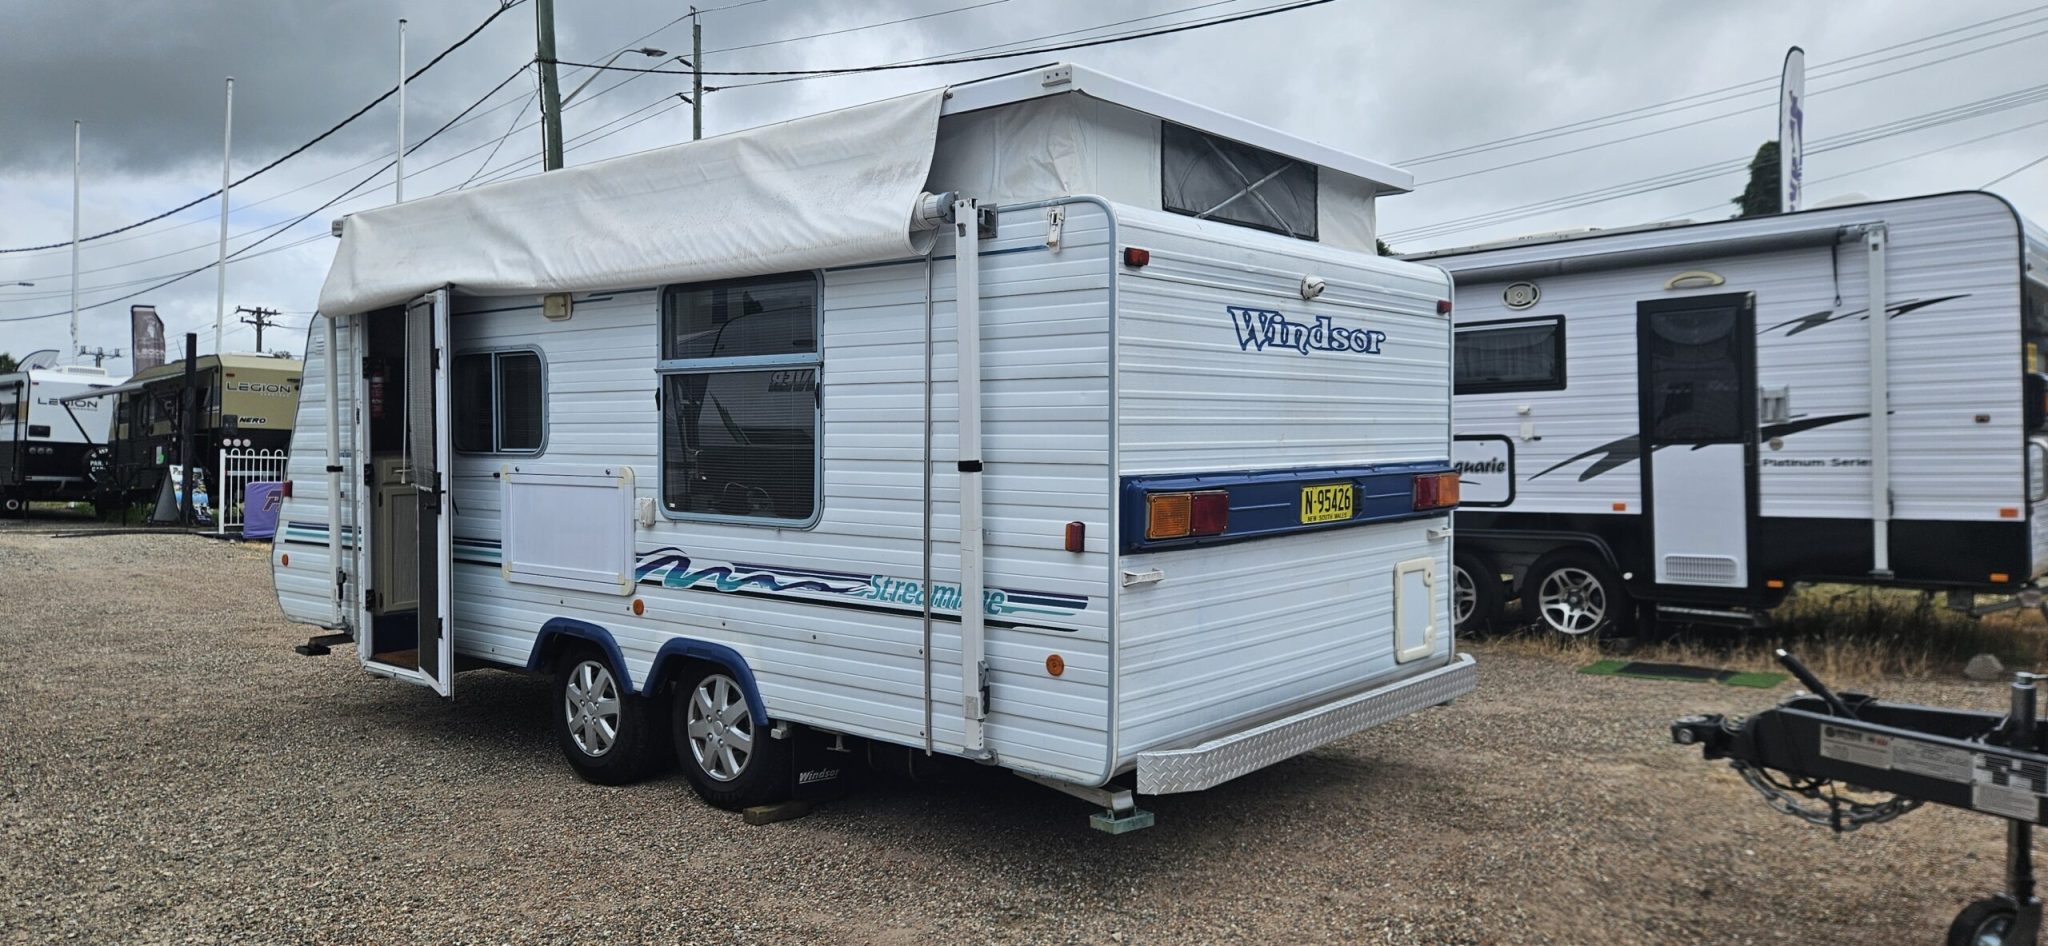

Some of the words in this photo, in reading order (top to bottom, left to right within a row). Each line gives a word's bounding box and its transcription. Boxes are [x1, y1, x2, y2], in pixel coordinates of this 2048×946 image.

[1227, 306, 1386, 356] Windsor
[226, 382, 291, 393] LEGION
[1454, 457, 1506, 477] quarie
[1763, 458, 1825, 467] Platinum
[799, 768, 840, 782] Windsor
